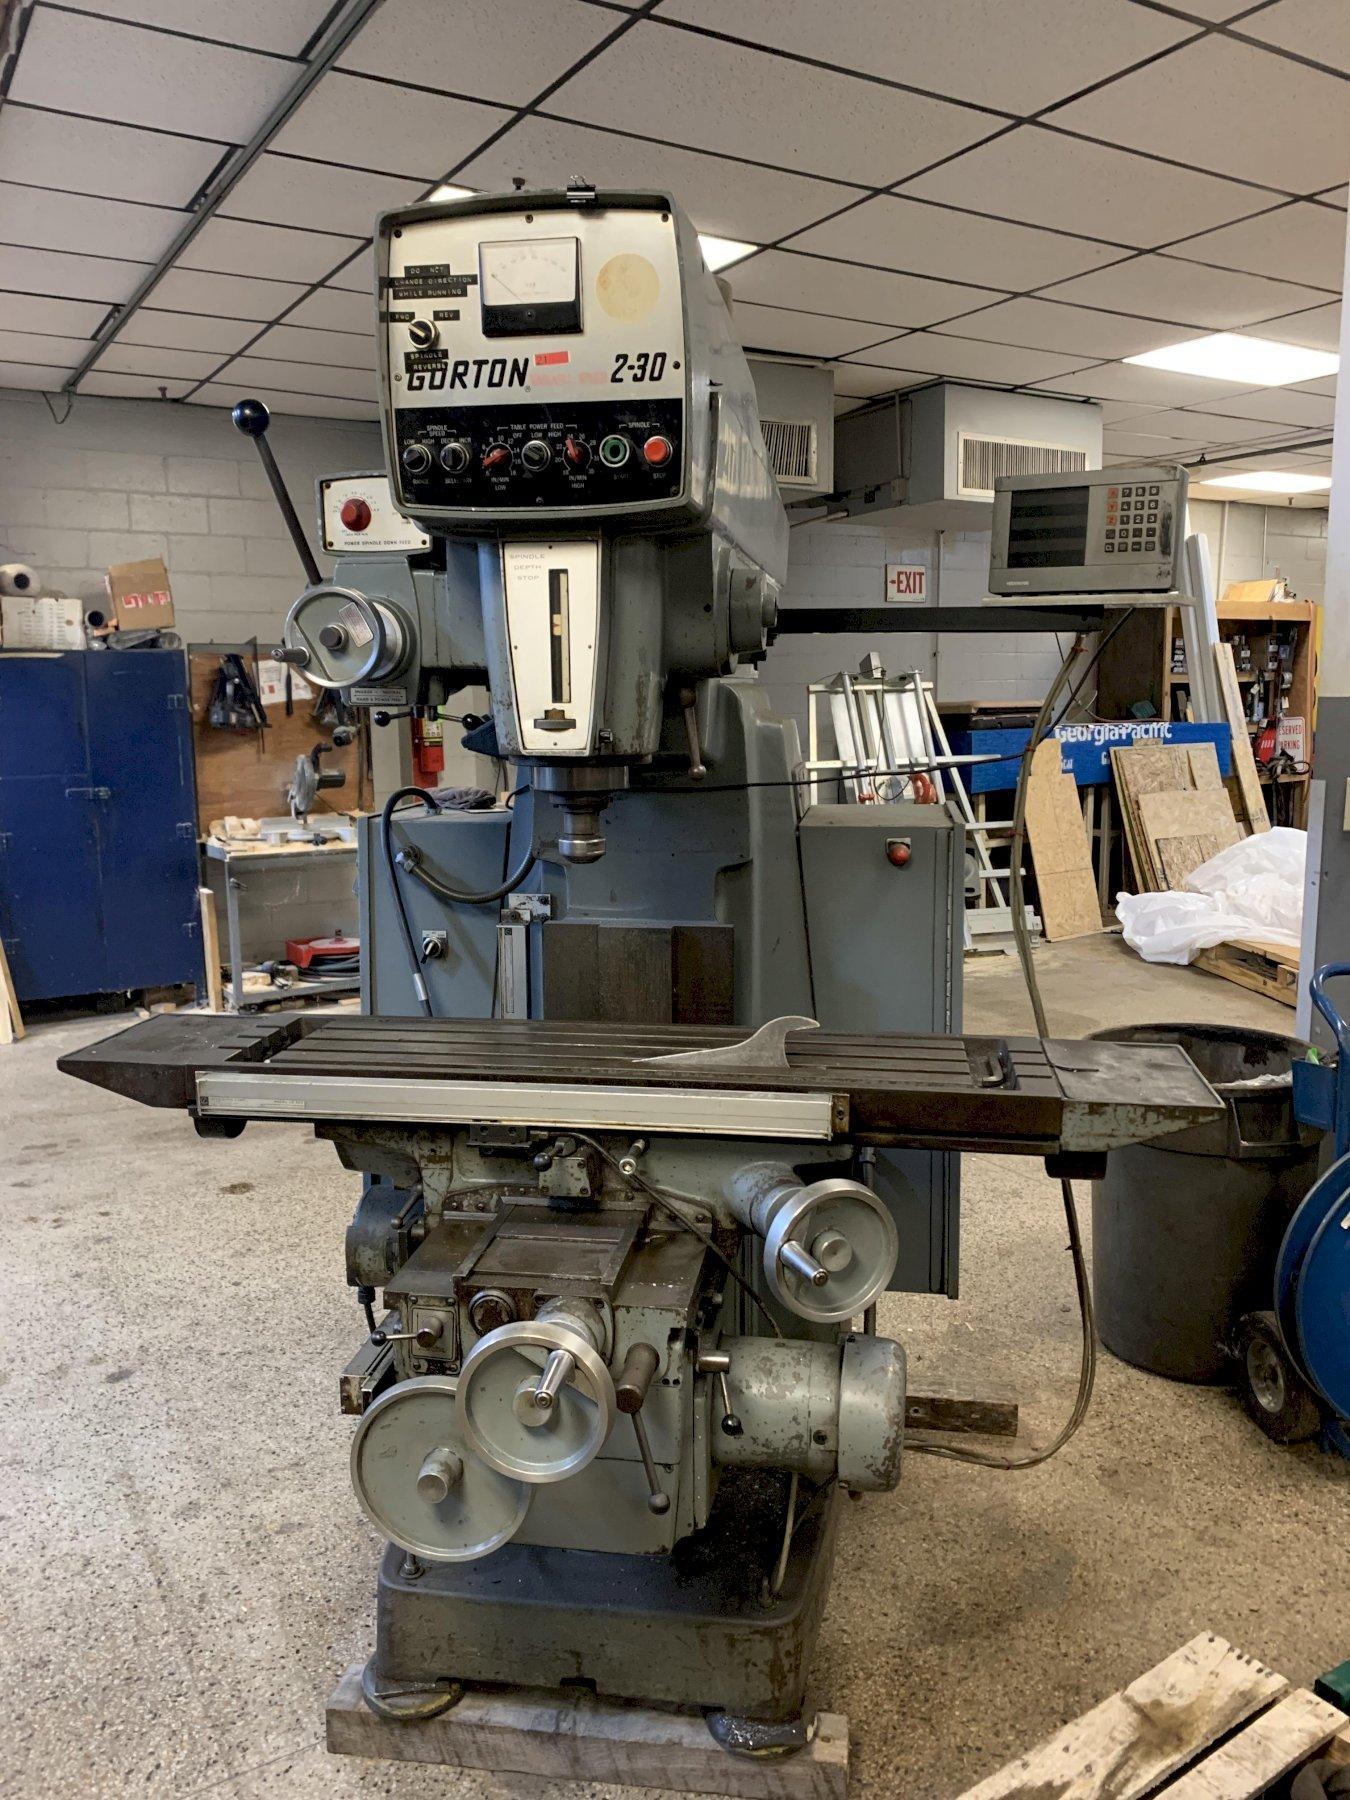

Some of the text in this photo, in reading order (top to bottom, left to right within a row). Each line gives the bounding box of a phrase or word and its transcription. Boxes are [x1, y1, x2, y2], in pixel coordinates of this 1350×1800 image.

[427, 277, 472, 285] DIRECTION
[427, 288, 462, 296] RUNNING
[409, 351, 443, 360] SPINDLE
[412, 362, 446, 371] REVERSE
[610, 352, 667, 383] 2-30
[407, 357, 529, 391] GORTON
[896, 570, 925, 594] EXIT
[1278, 724, 1304, 736] ESERVED
